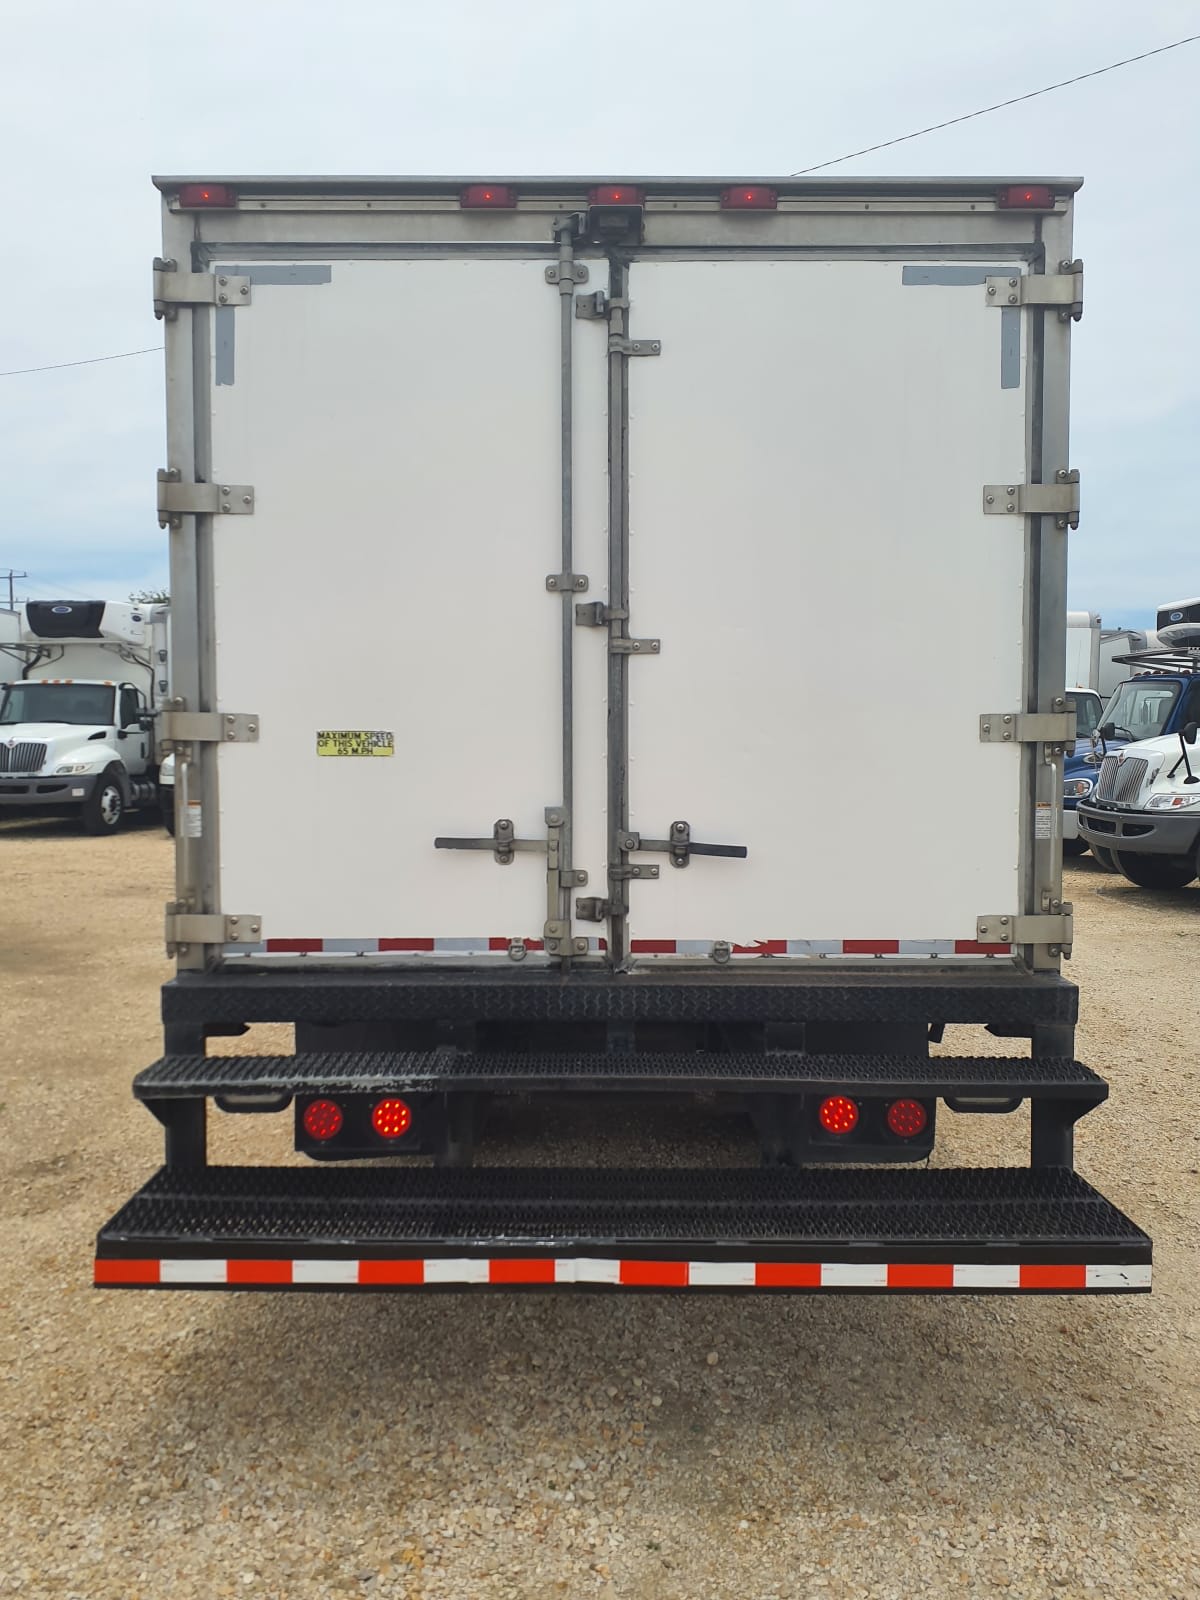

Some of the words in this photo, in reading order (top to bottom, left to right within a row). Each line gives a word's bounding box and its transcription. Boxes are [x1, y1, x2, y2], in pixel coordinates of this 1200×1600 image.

[317, 739, 330, 747] OF
[333, 739, 352, 747] THIS
[356, 739, 393, 748] VEHICLE
